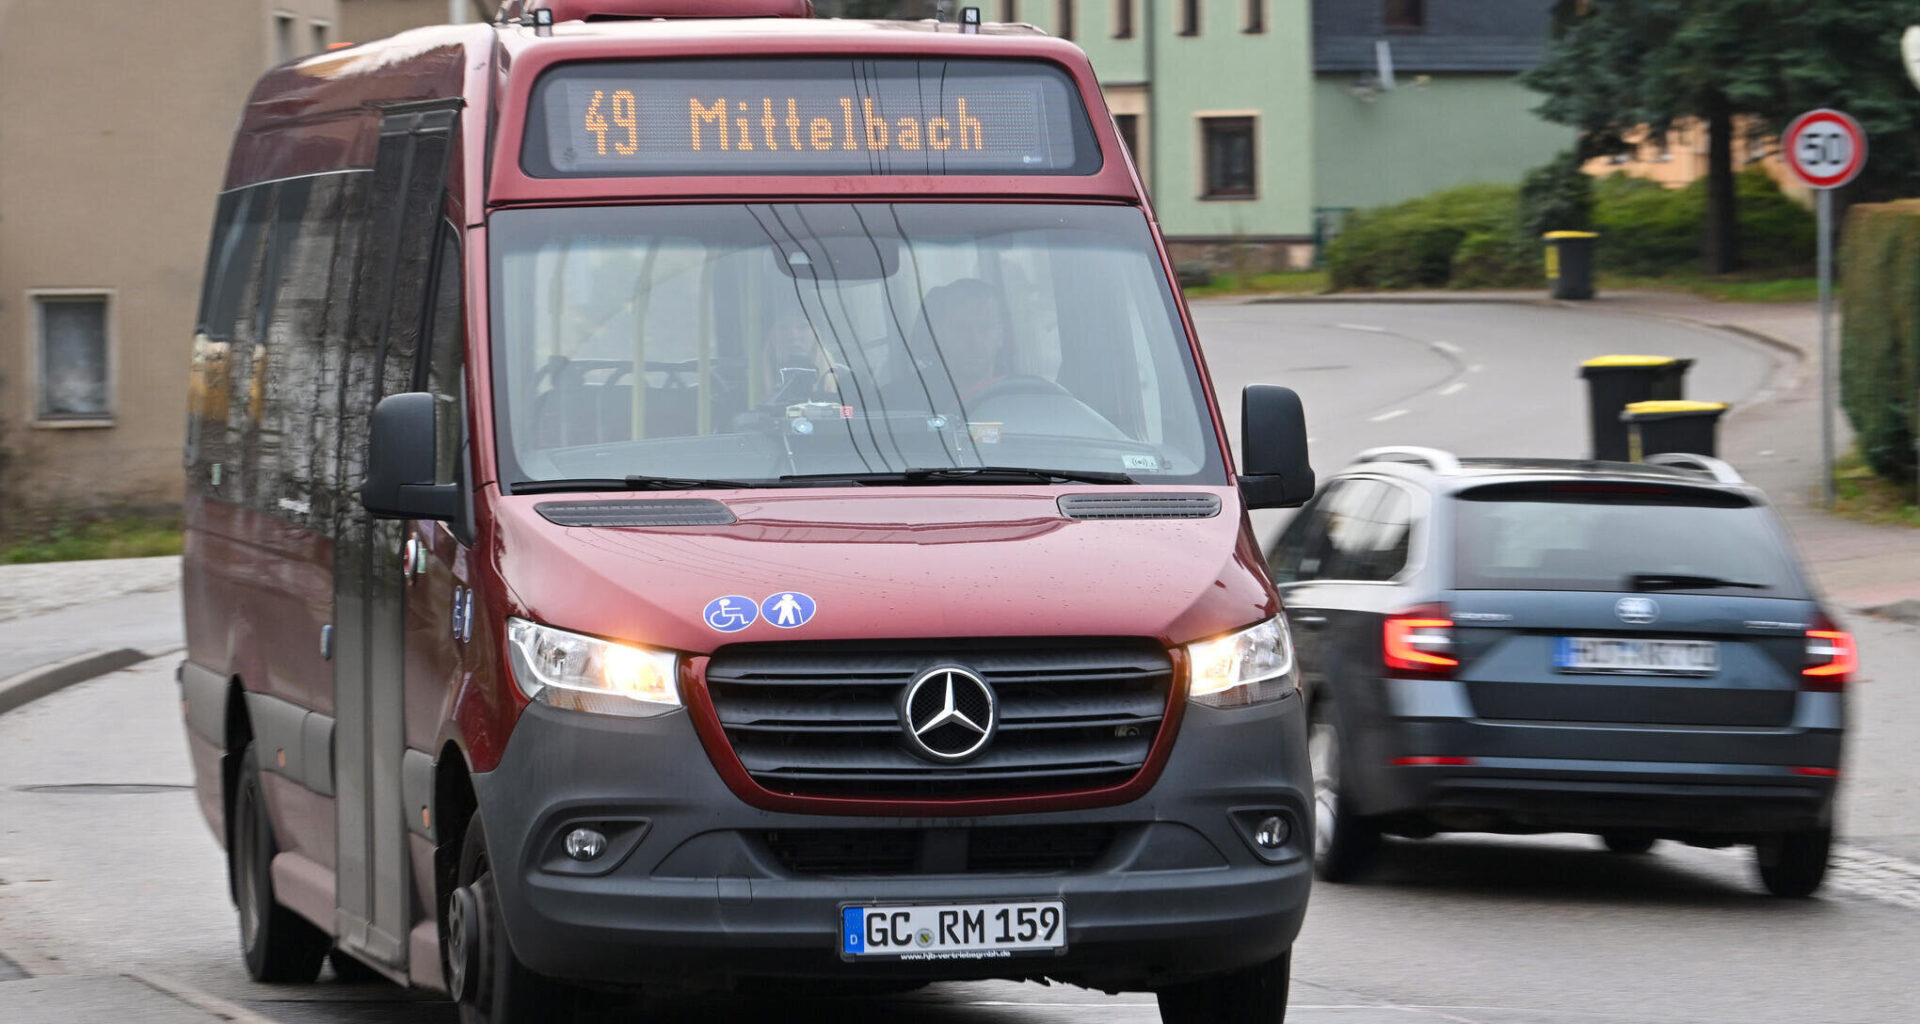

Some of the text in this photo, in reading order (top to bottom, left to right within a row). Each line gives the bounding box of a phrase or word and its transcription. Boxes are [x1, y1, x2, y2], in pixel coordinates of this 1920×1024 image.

[585, 90, 983, 155] 49 Mittelbach
[1801, 132, 1848, 166] 50
[850, 906, 1060, 947] D GC RM 159
